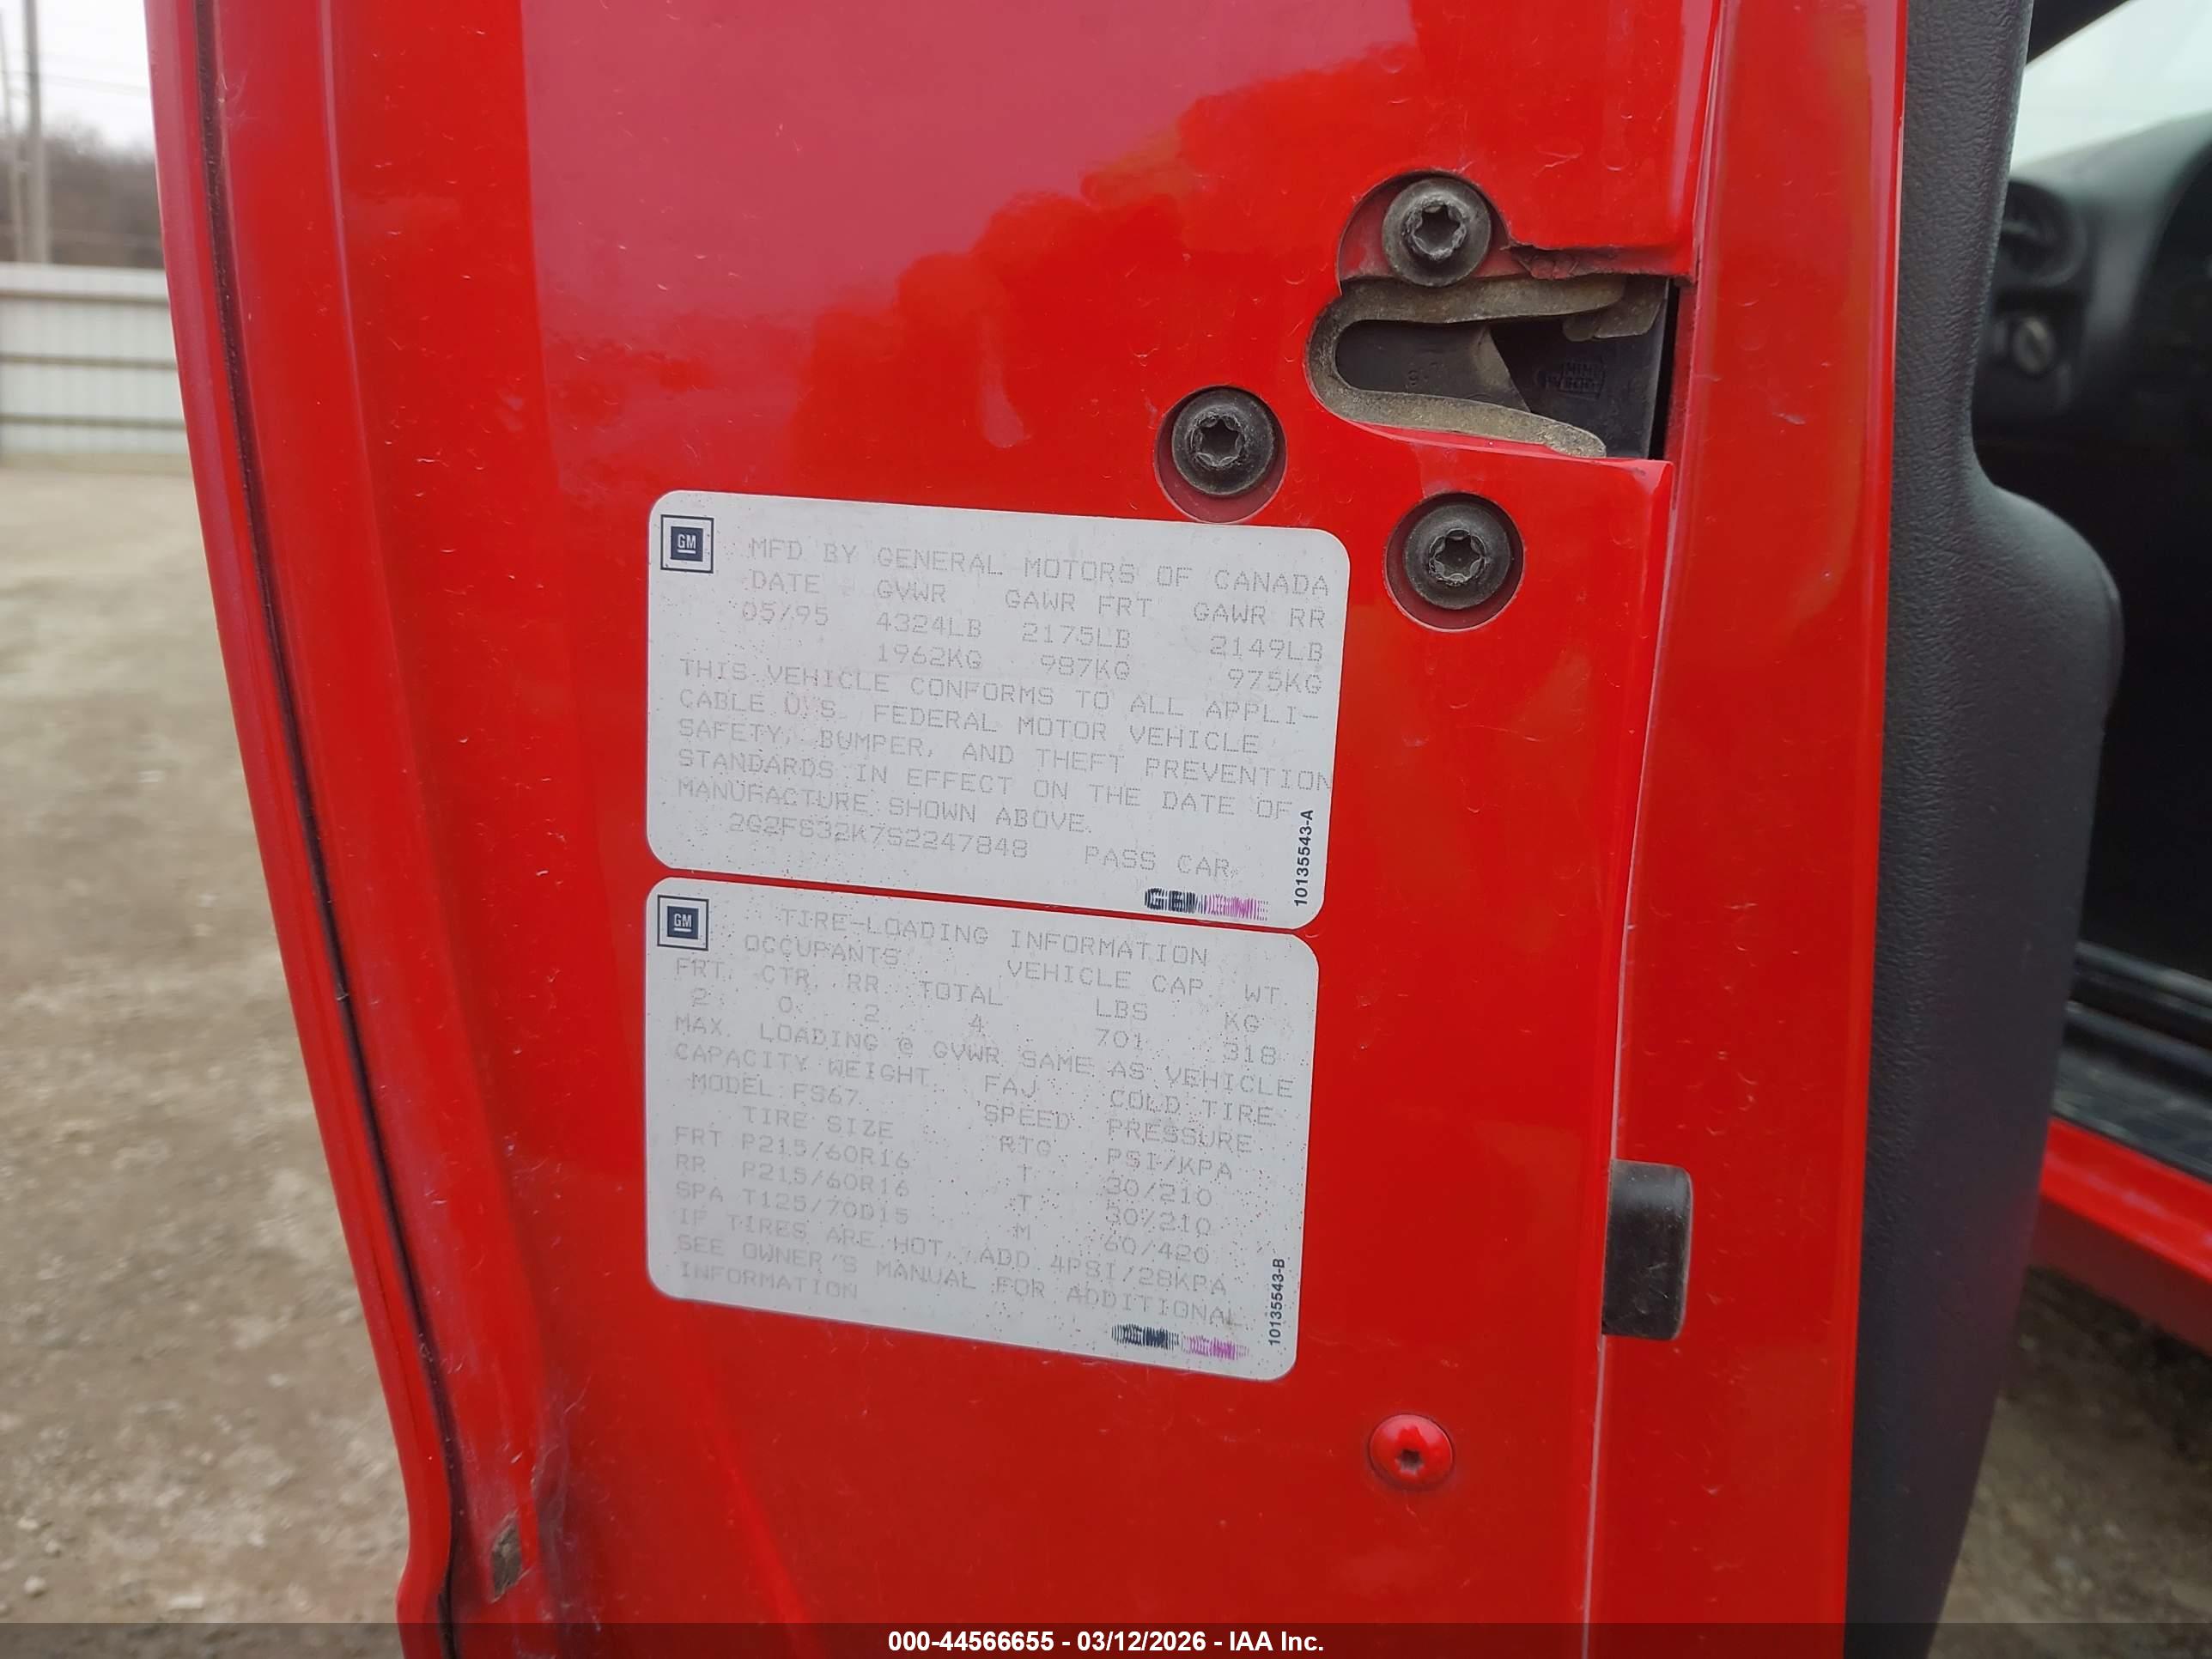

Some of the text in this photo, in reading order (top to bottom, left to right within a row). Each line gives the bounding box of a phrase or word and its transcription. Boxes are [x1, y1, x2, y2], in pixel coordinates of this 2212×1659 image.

[677, 533, 696, 550] GM
[752, 537, 1329, 596] MFD BY GENERAL MOTORS OF CANADA
[742, 601, 1322, 662] 05/95 4324LB 2175LB 2149LB
[752, 570, 1325, 629] DATE GVWR GAWR FRT GAWR RR
[680, 658, 1319, 725] THIS VEHICLE CONFORMS TO ALL APPLI-
[878, 643, 1322, 695] 1962KG 987KG 975KG
[678, 718, 1332, 790] SAFETY, BUMPER, AND THEFT PREVENTION
[680, 689, 765, 714] CABLE
[874, 704, 996, 732] FEDERAL
[1018, 716, 1106, 741] MOTOR
[1130, 725, 1259, 754] VEHICLE
[678, 749, 1292, 818] STANDARDS IN EFFECT ON THE DATE OF
[678, 779, 868, 812] MANUFACTURE
[889, 797, 975, 823] SHOWN
[1085, 845, 1156, 870] PASS
[1294, 810, 1313, 906] 10135543-A
[673, 913, 692, 928] GM
[781, 908, 1207, 966] TIRE-LOADING INFORMATION
[744, 934, 898, 965] OCCUPANTS
[1007, 960, 1131, 988] VEHICLE
[692, 988, 709, 1006] 2
[865, 1004, 879, 1023] 2
[969, 1013, 982, 1032] 4
[1097, 1028, 1141, 1050] 701
[1223, 1042, 1276, 1066] 318
[920, 981, 1003, 1006] TOTAL
[1097, 998, 1147, 1020] LBS
[1224, 1012, 1259, 1032] KG
[676, 1042, 1274, 1127] CAPACITY WEIGHT FAJ COLD TIRE
[761, 1023, 878, 1052] LOADING
[898, 1036, 913, 1056] @
[933, 1041, 1000, 1064] GVWR
[1022, 1050, 1094, 1074] SAME
[1109, 1061, 1145, 1080] AS
[1166, 1067, 1293, 1098] VEHICLE
[691, 1073, 1252, 1153] MODEL FS67 SPEED PRESSURE
[743, 1106, 1232, 1180] TIRE SIZE RTG PSI/KPA
[675, 1126, 1212, 1207] FRT P215/60R16 T 30/210
[676, 1153, 1212, 1237] RR P215/60R16 T 30/210
[676, 1181, 1210, 1265] SPA T125/70D15 M 60/420
[680, 1208, 708, 1226] IF
[729, 1213, 807, 1241] TIRES
[826, 1226, 876, 1249] ARE
[980, 1246, 1030, 1268] ADD
[1049, 1254, 1226, 1295] 4PSI/28KPA
[678, 1234, 725, 1256] SEE
[876, 1260, 976, 1290] MANUAL
[996, 1276, 1045, 1298] FOR
[1066, 1285, 1243, 1327] ADDITIONAL
[681, 1261, 857, 1299] INFORMATION
[1268, 1258, 1285, 1346] 10135543-B
